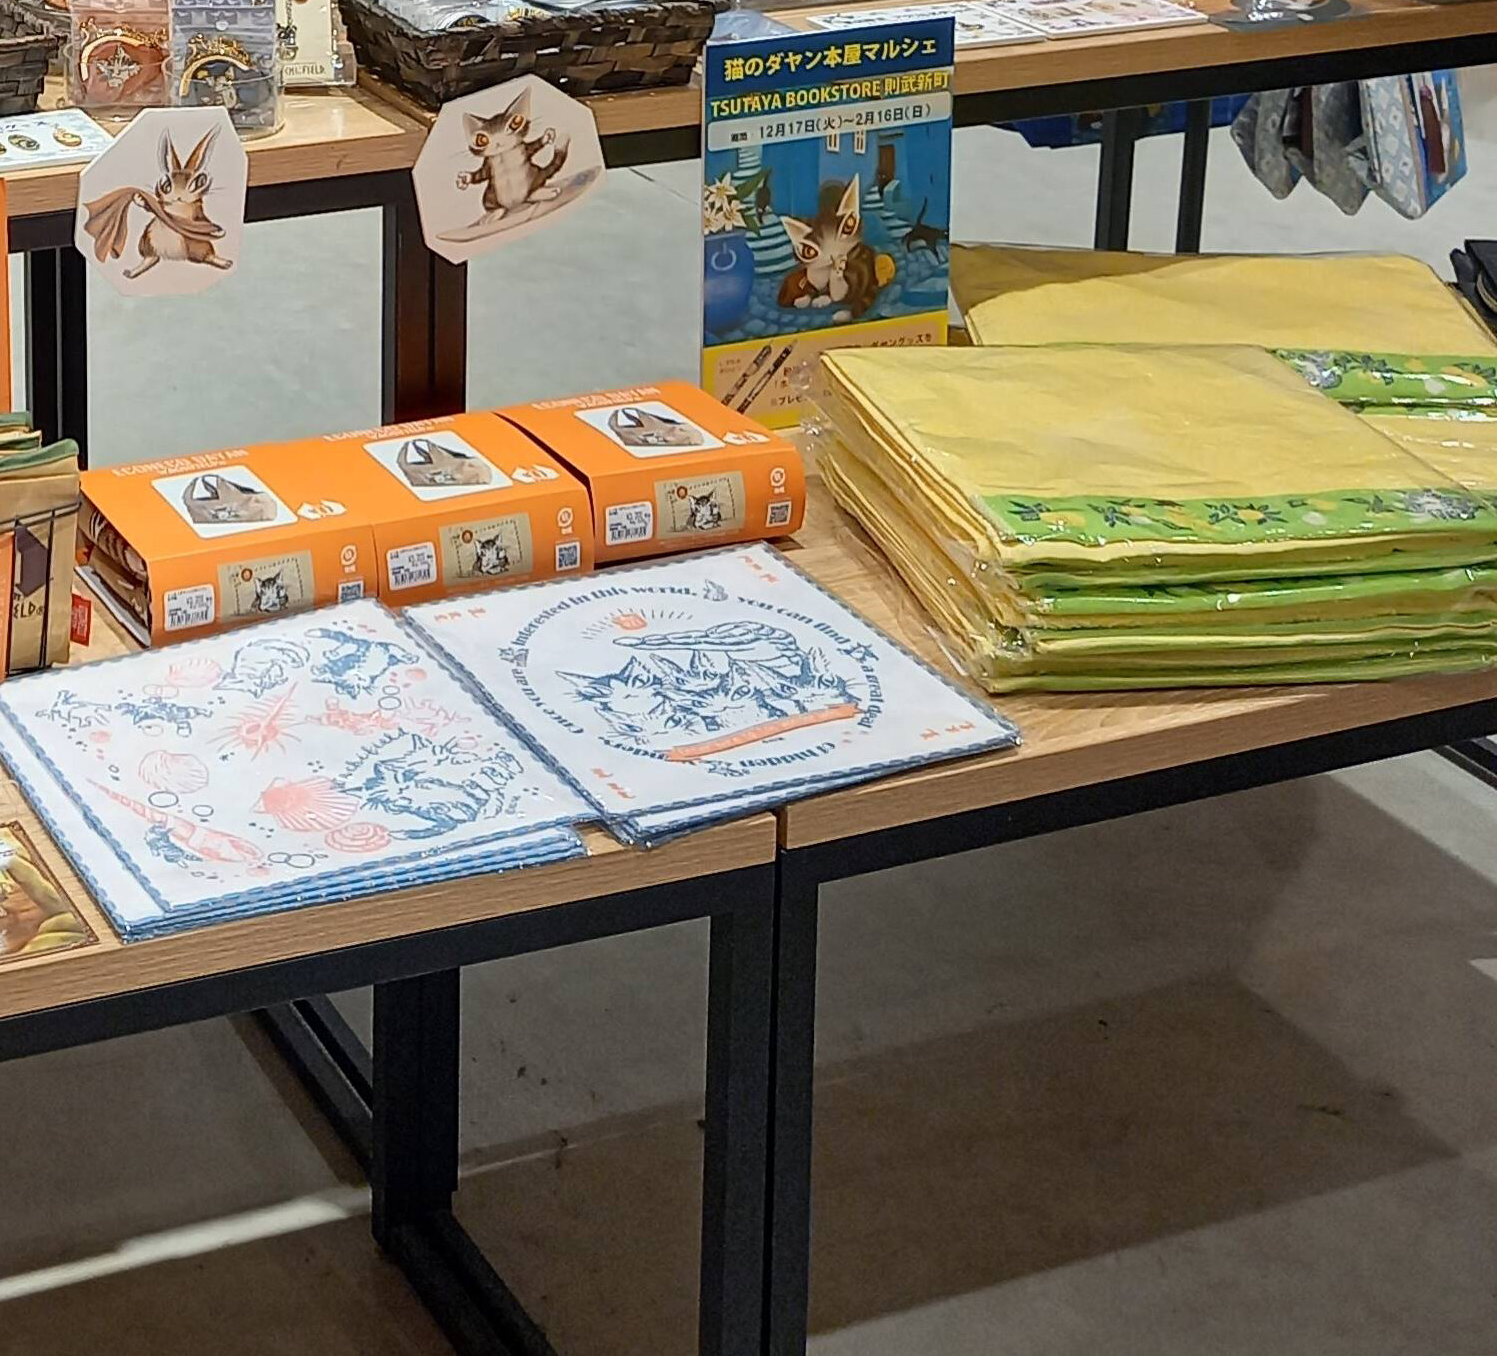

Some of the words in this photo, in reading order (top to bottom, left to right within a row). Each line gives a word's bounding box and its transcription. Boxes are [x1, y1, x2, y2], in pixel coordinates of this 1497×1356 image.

[724, 40, 937, 82] 猫のダヤン本屋マルシェ
[711, 93, 782, 118] TSUTAYA
[786, 81, 881, 107] BOOKSTORE
[884, 72, 950, 95] 則武新町
[590, 586, 628, 600] this
[630, 583, 698, 596] world,
[570, 593, 590, 607] in
[737, 596, 772, 611] you
[512, 596, 570, 646] interested
[776, 607, 813, 624] can
[739, 746, 816, 769] hidden
